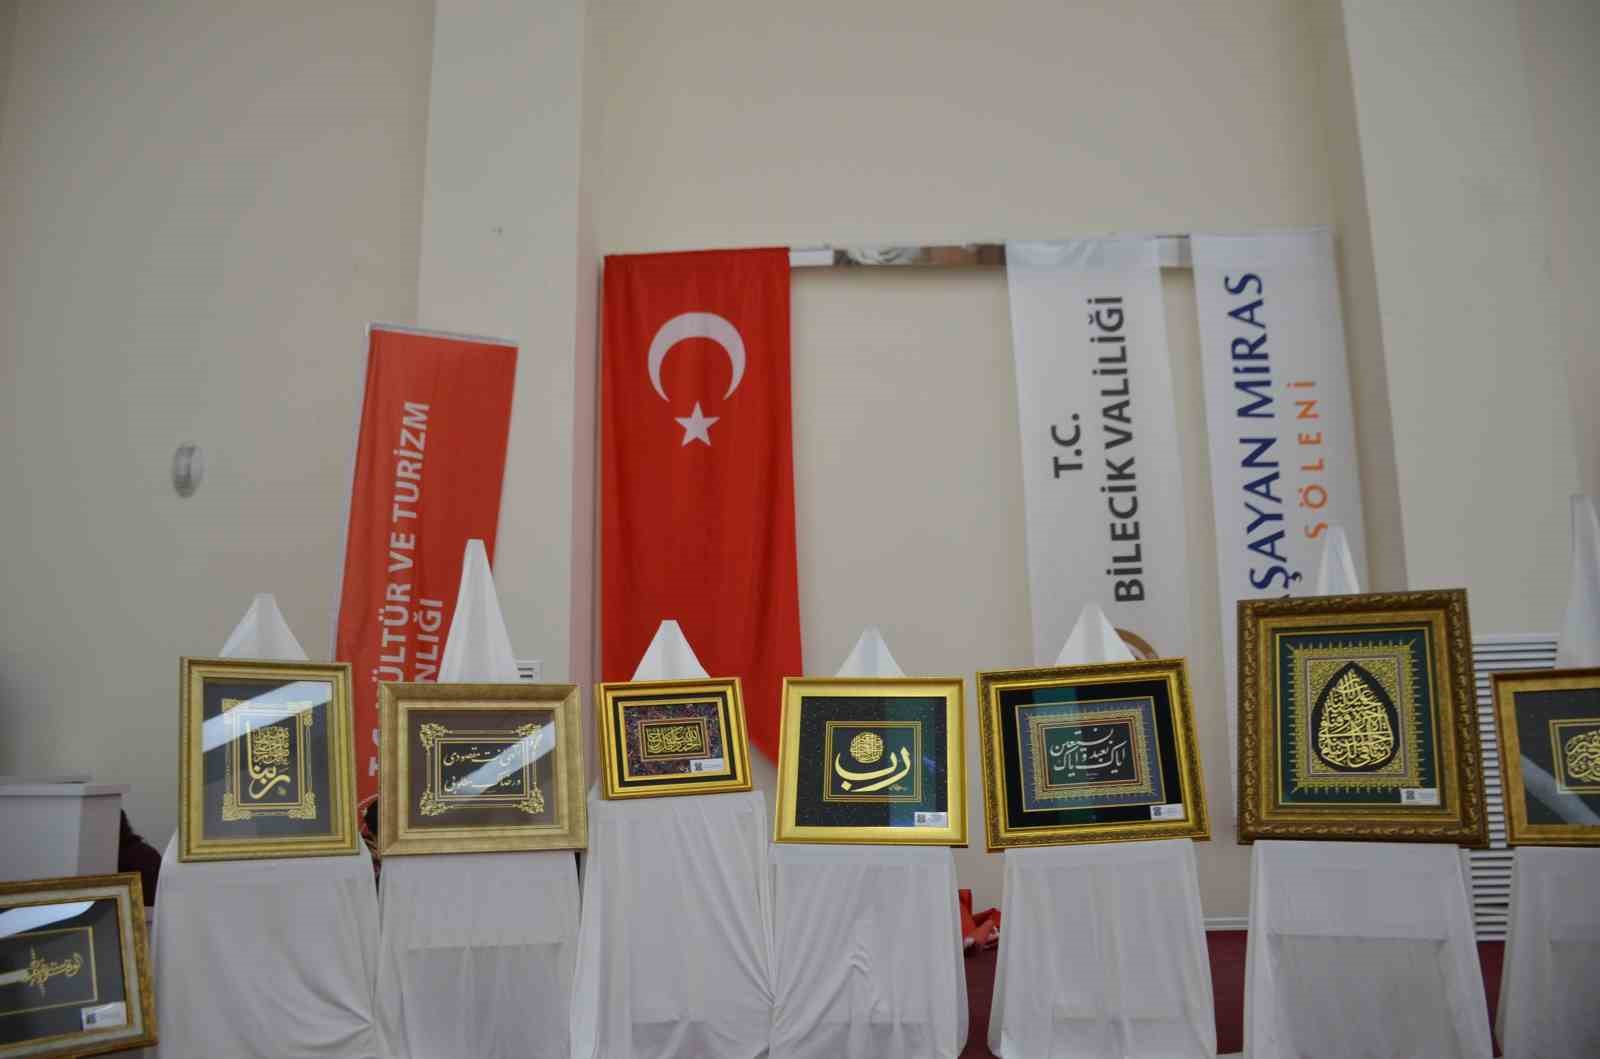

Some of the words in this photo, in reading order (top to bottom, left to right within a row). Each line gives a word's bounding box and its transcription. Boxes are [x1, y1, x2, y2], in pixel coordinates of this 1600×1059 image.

[1087, 296, 1133, 449] VALİLİĞİ
[1225, 273, 1275, 418] MİRAS
[392, 400, 431, 523] TURİZM
[1050, 413, 1083, 478] T.C.
[387, 531, 416, 573] VE
[1100, 457, 1145, 602] BİLECİK
[1240, 438, 1302, 599] ŞAYAN
[371, 583, 412, 692] ÜLTÜR
[414, 599, 443, 684] NLIĞI
